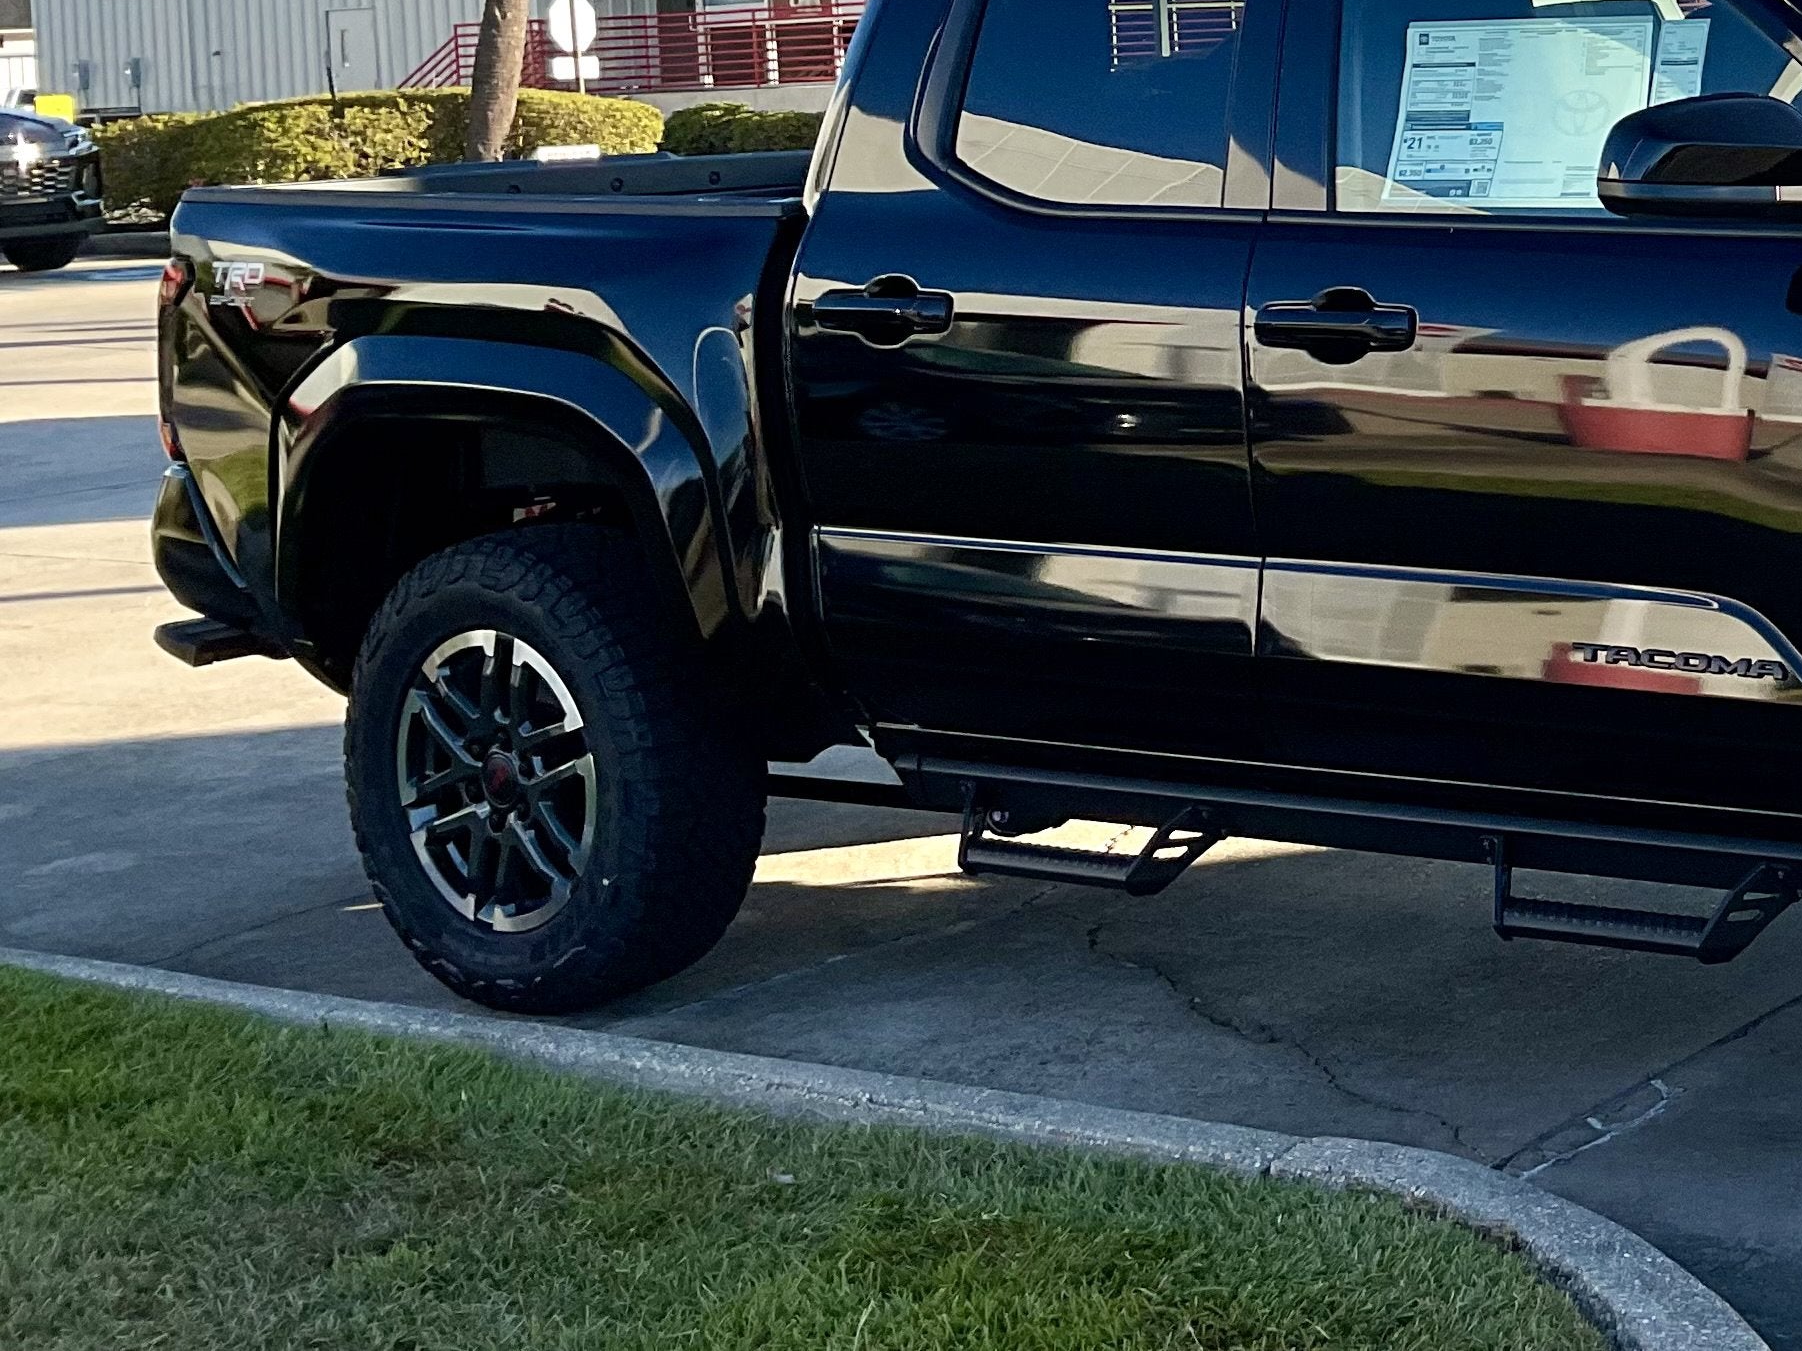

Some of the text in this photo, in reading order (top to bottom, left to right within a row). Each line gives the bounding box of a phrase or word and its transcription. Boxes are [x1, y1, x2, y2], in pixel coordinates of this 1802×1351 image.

[1407, 136, 1423, 150] 21
[212, 261, 265, 292] TRD
[1572, 642, 1789, 681] TACOMA
